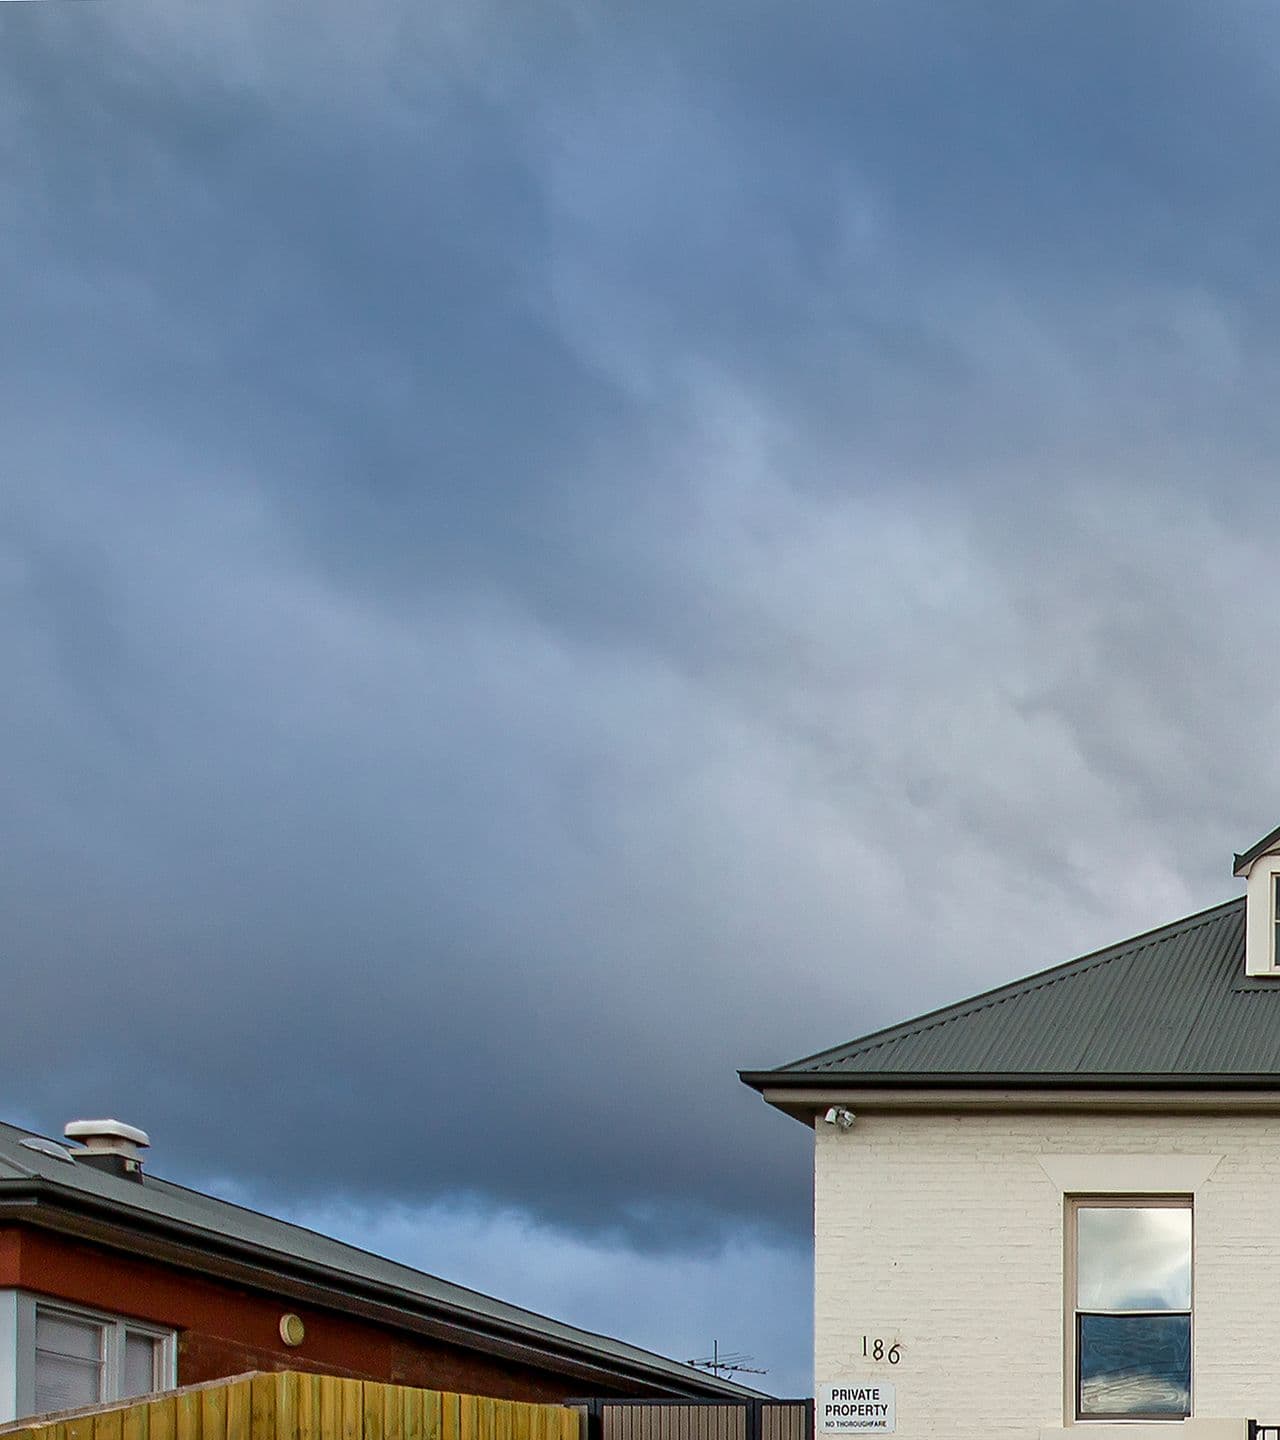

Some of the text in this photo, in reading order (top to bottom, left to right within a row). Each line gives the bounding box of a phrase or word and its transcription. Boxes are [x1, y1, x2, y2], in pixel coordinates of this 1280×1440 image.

[862, 1335, 901, 1365] 186
[831, 1388, 880, 1401] PRIVATE
[825, 1404, 888, 1416] PROPERTY
[825, 1420, 887, 1428] NO THOROUGHFARE
